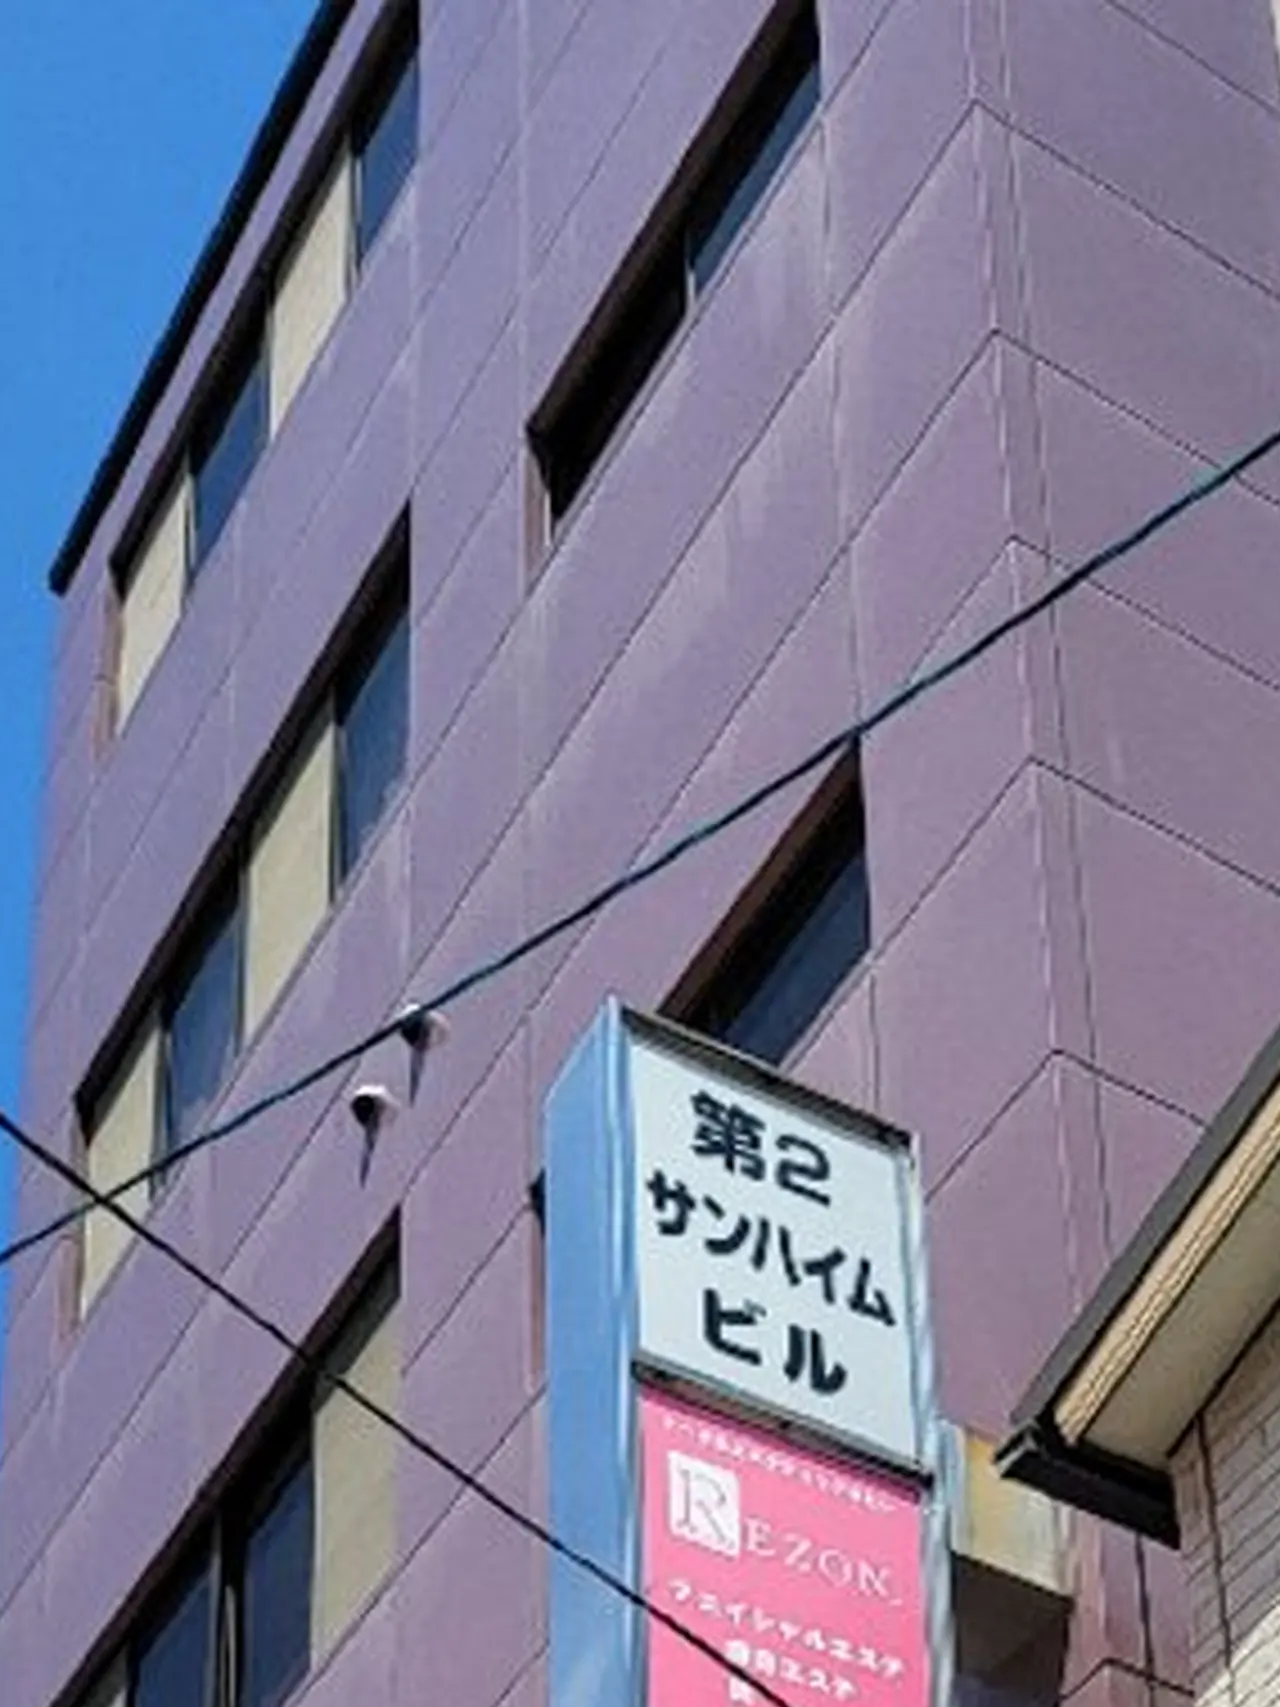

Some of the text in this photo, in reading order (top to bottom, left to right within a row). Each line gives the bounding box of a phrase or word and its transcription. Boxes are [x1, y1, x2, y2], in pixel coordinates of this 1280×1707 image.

[690, 1091, 831, 1206] 第2
[646, 1170, 896, 1326] サンハイム
[704, 1287, 847, 1394] ビル
